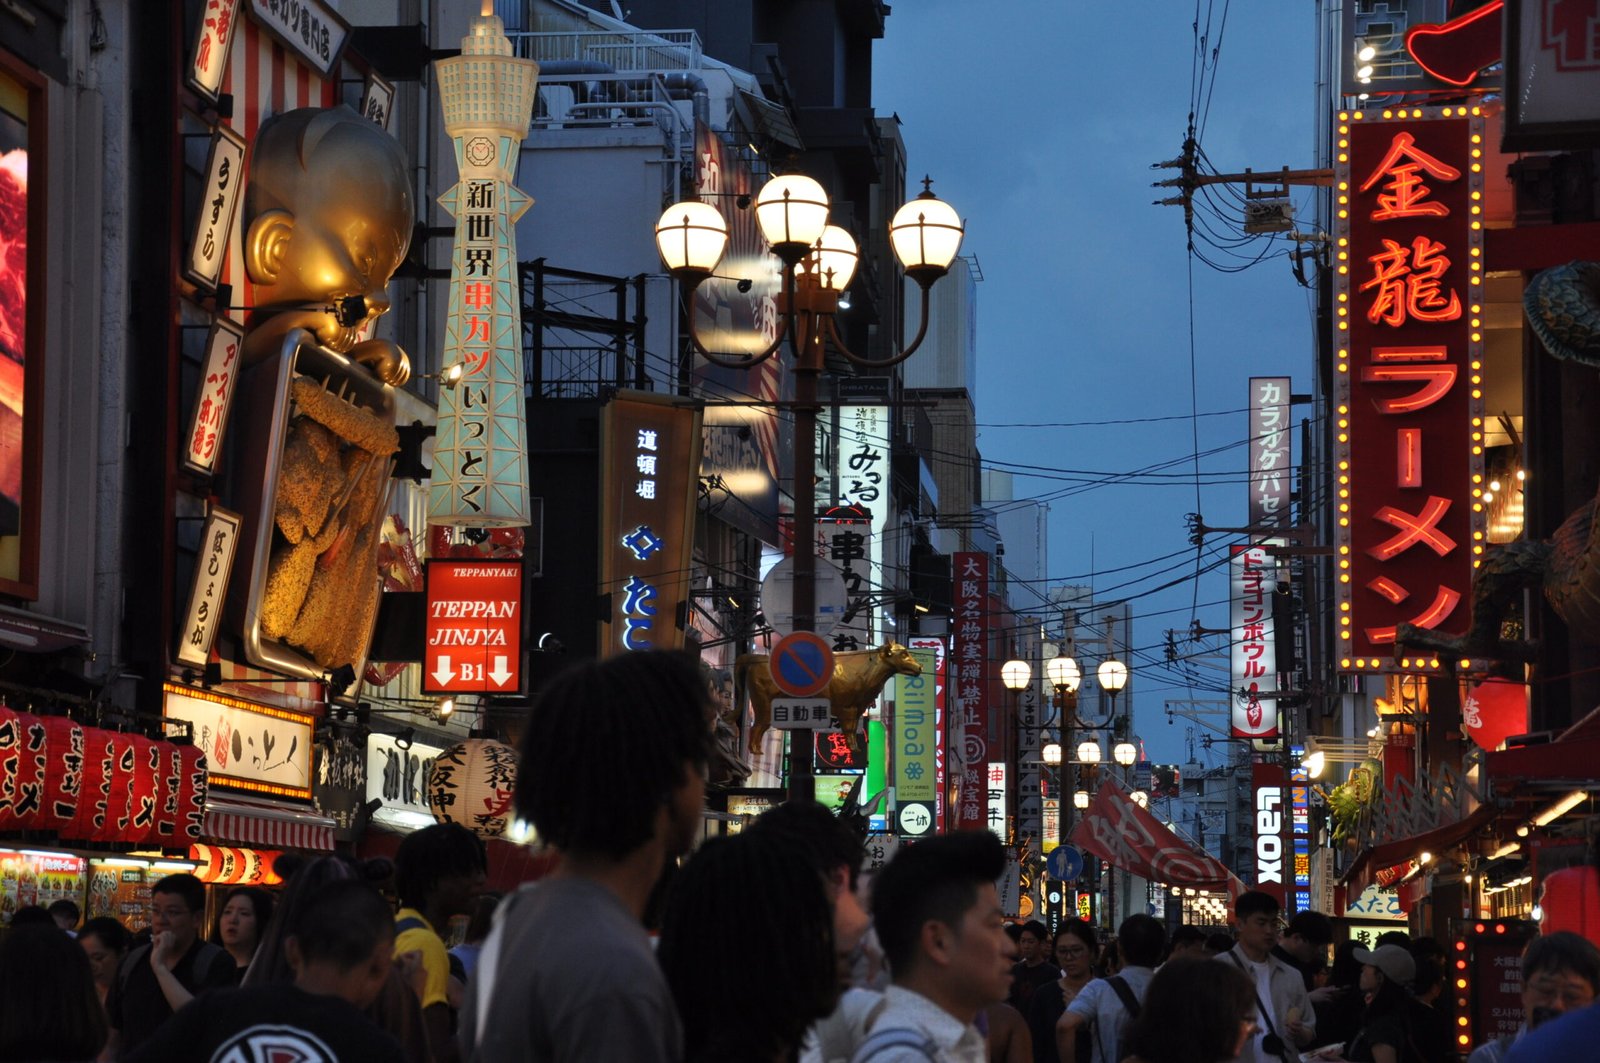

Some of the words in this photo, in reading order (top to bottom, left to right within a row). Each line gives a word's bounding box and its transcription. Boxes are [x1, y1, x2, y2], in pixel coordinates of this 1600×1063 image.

[1360, 131, 1461, 645] 金龍ラーメン
[636, 429, 658, 500] 道頓堀
[453, 568, 518, 577] TEPPANYAKI
[431, 601, 517, 618] TEPPAN
[1243, 553, 1265, 678] ドラゴンボウル
[429, 628, 507, 646] JINJYA
[459, 664, 484, 681] B1
[773, 705, 828, 721] 自動車
[904, 815, 928, 826] 一休
